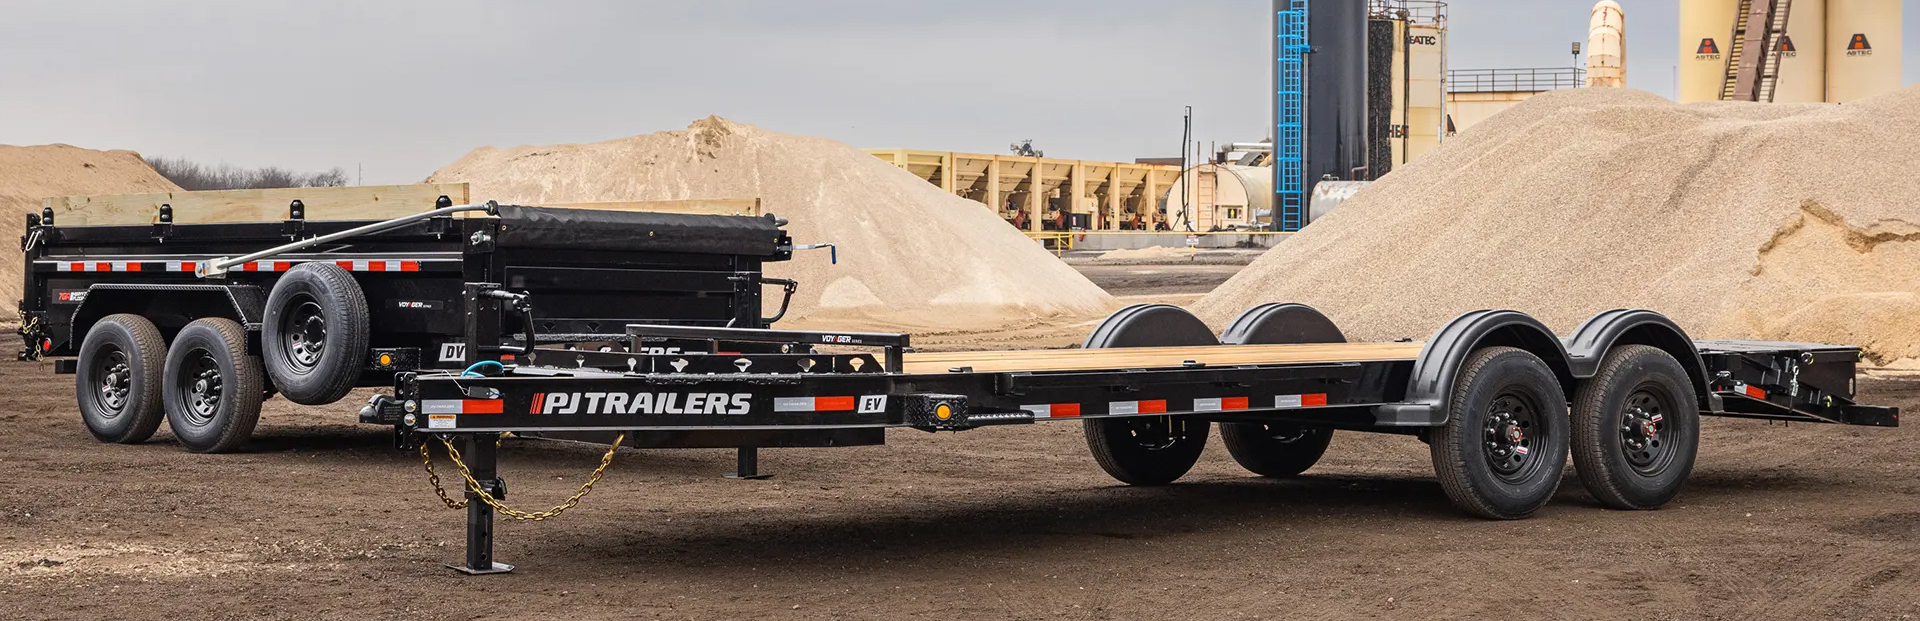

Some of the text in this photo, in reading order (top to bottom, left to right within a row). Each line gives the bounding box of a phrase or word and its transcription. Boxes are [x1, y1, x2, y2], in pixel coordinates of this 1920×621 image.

[822, 334, 851, 344] VOYAGER
[445, 345, 465, 359] DV
[543, 392, 752, 415] PJ TRAILERS
[864, 398, 882, 411] EV
